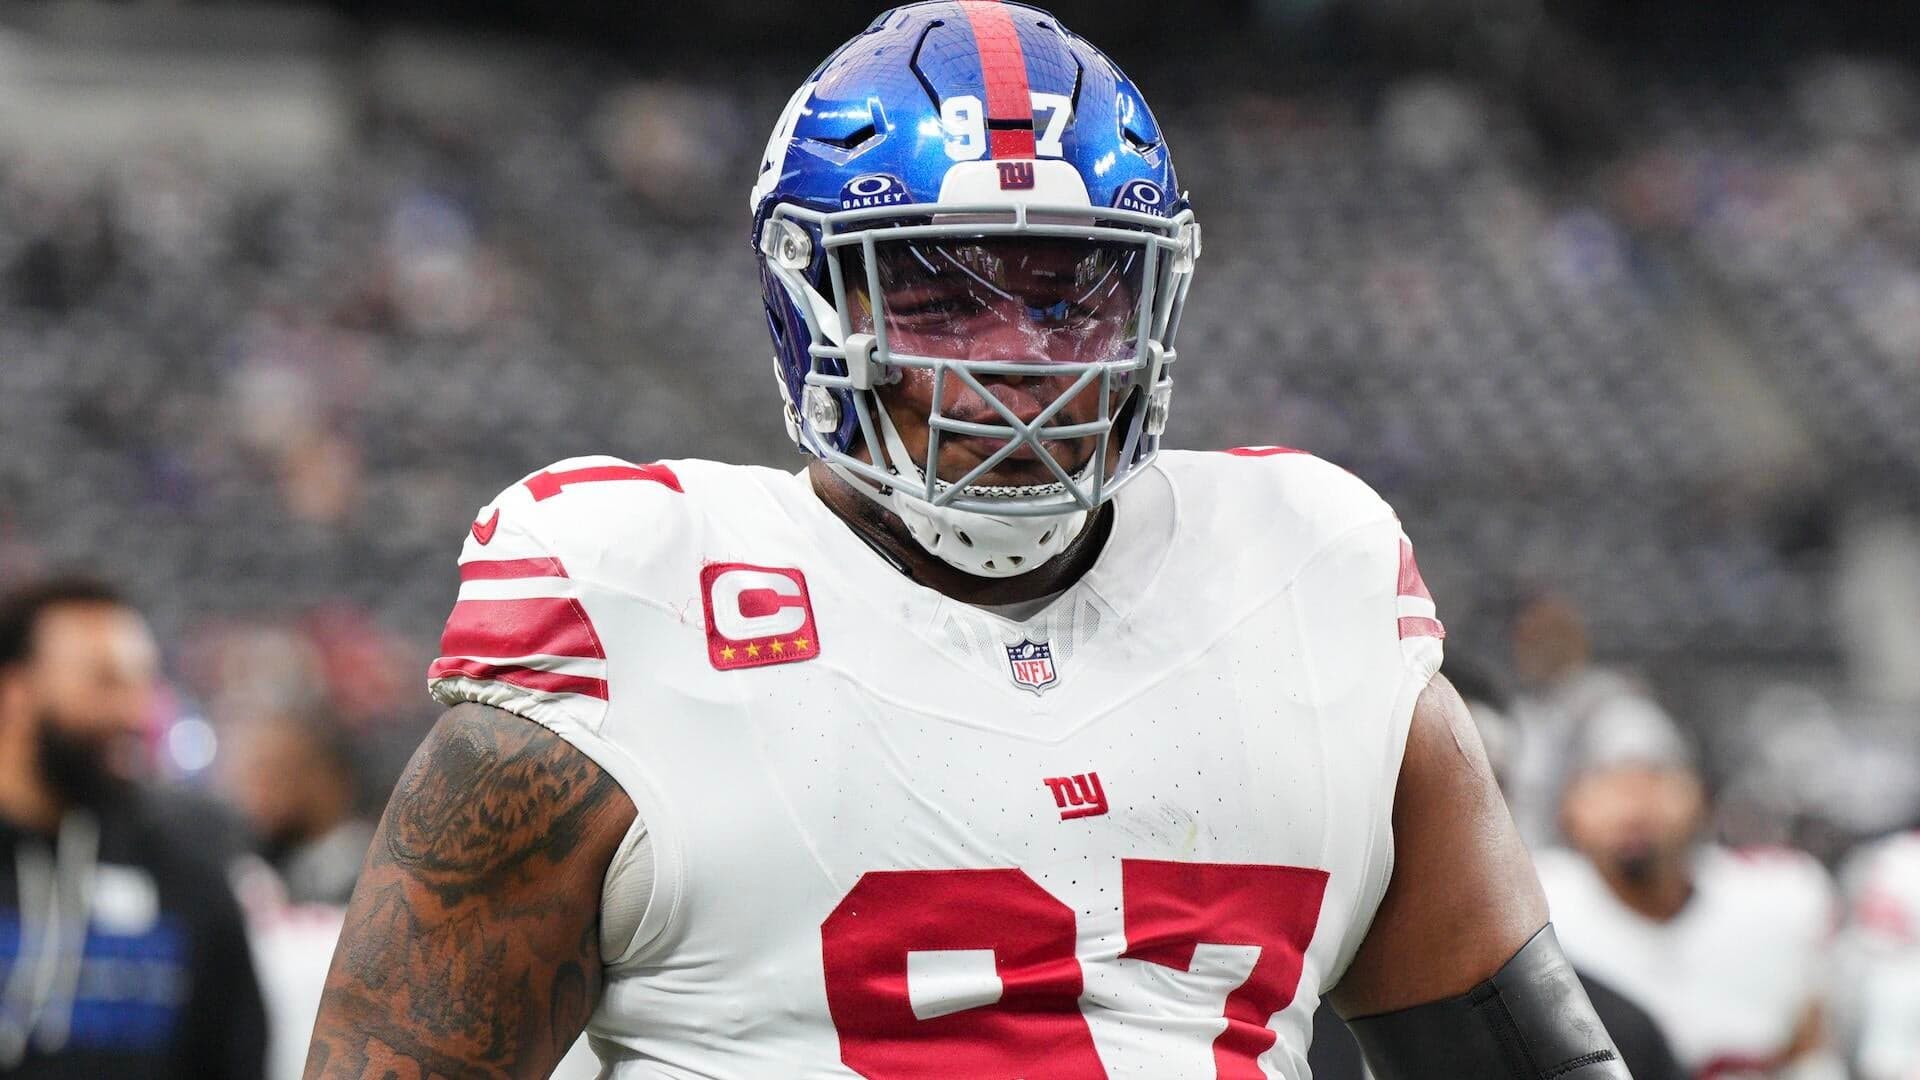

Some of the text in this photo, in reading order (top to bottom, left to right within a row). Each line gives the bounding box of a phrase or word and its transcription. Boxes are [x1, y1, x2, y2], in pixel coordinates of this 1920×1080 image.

[940, 92, 1072, 161] 97
[842, 192, 902, 210] OAKLEY
[710, 569, 807, 641] C
[1015, 660, 1053, 684] NFL
[820, 857, 1330, 1080] 97
